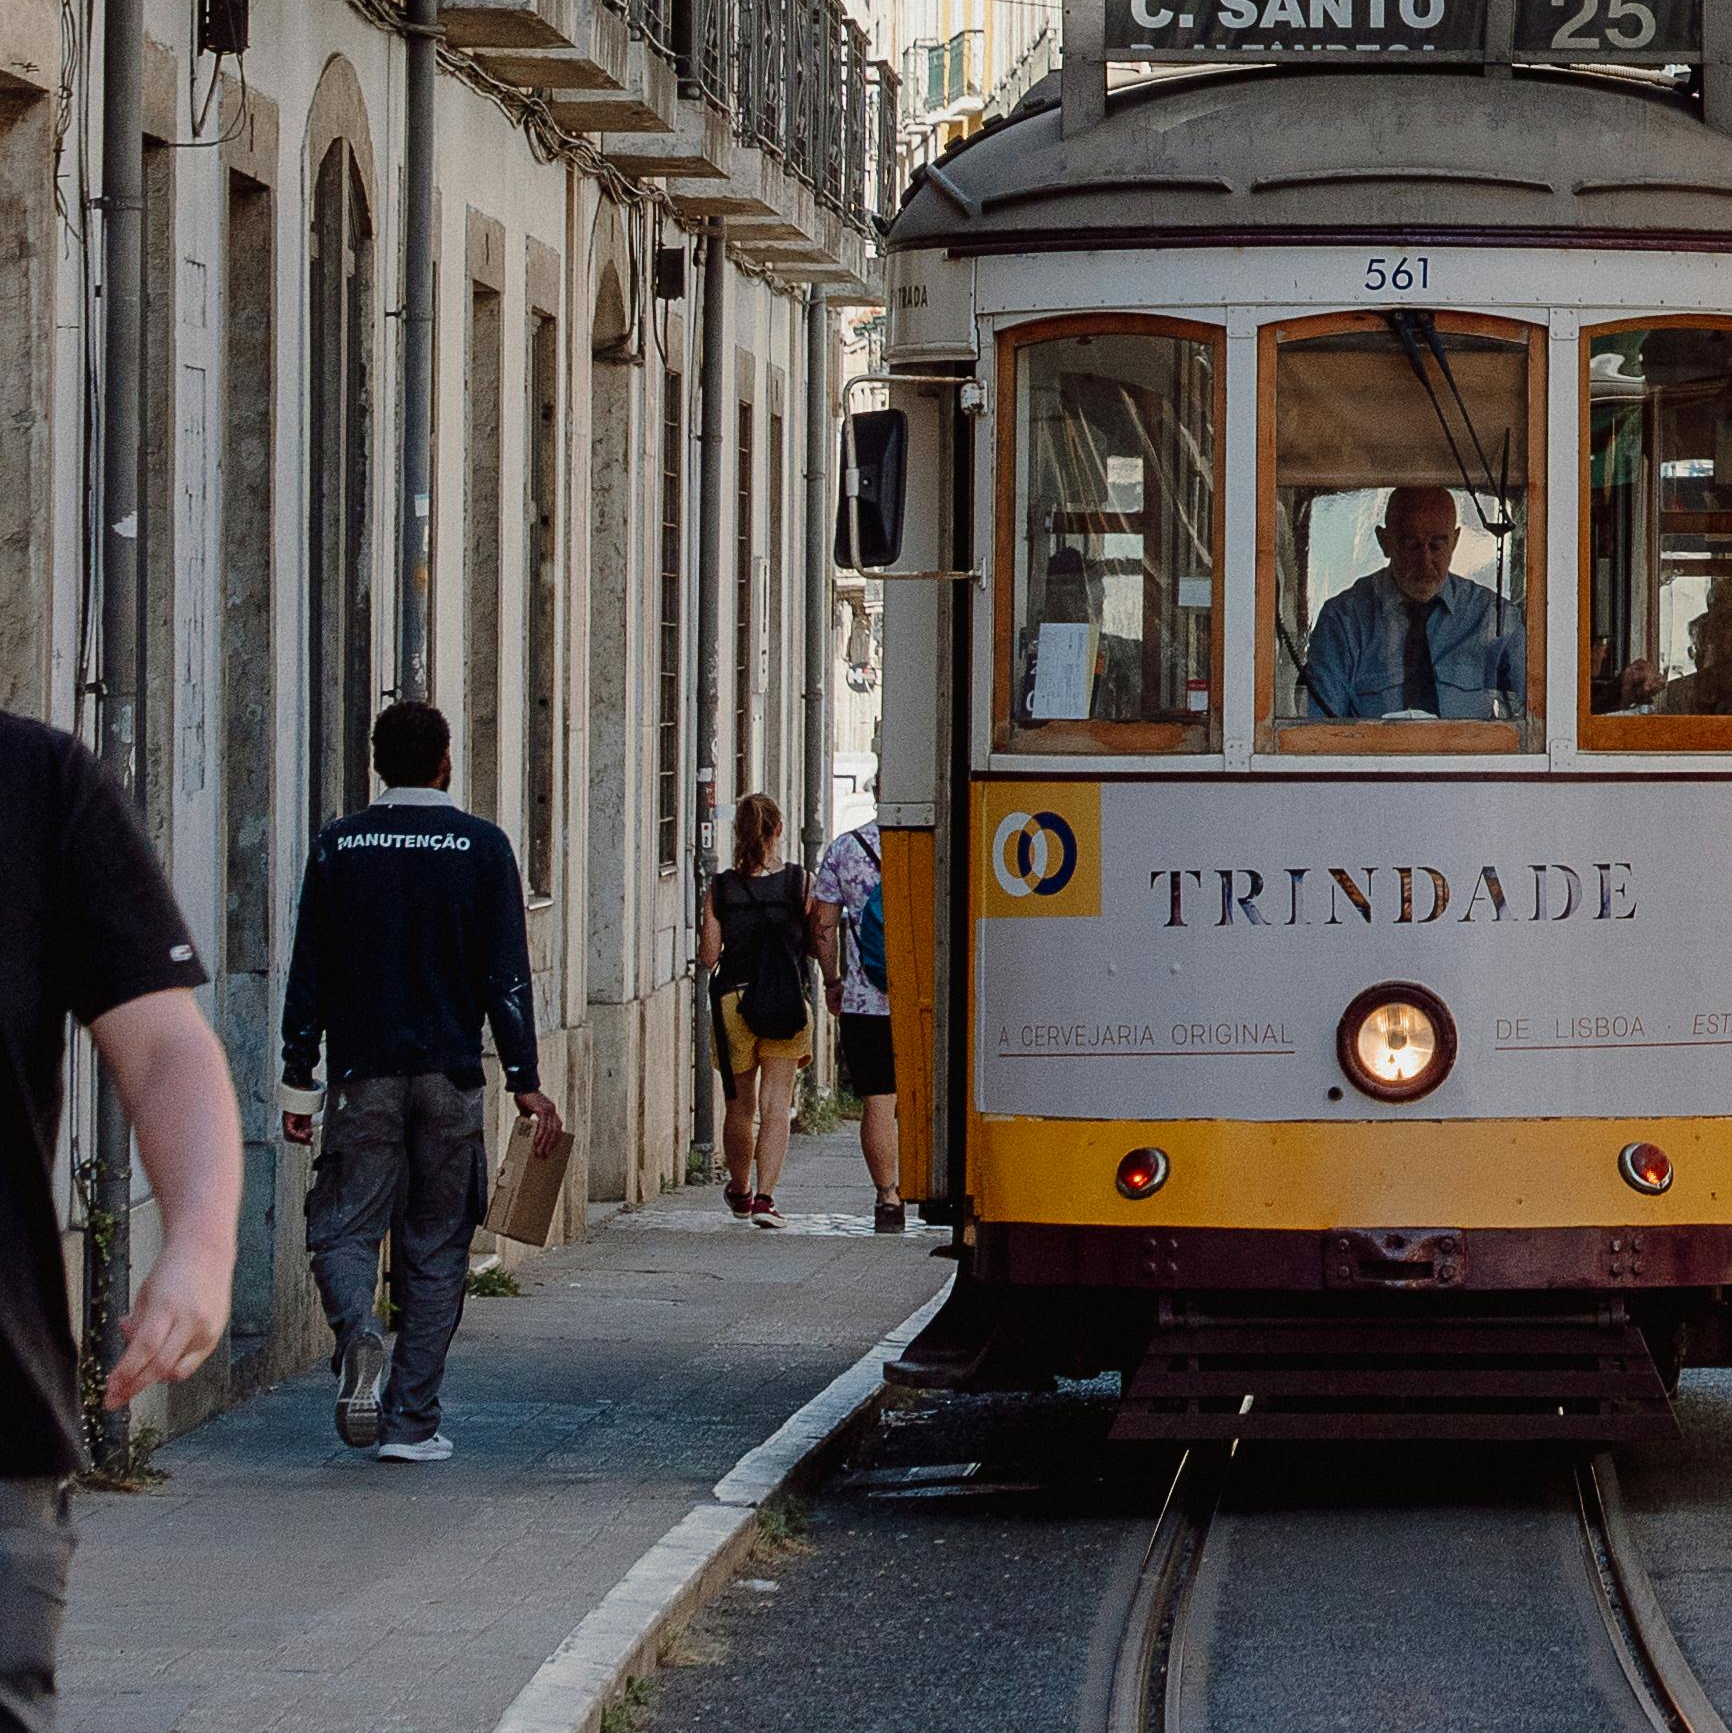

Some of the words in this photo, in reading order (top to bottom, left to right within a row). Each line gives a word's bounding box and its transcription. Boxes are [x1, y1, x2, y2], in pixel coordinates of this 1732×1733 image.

[1364, 257, 1429, 290] 561
[338, 833, 472, 851] MANUTENÇÃO
[1150, 863, 1638, 927] TRINDADE
[999, 1026, 1010, 1047] A
[1021, 1024, 1155, 1047] CERVEJARIA
[1171, 1023, 1294, 1046] ORIGINAL
[1496, 1019, 1530, 1040] DE
[1555, 1016, 1646, 1039] LISBOA
